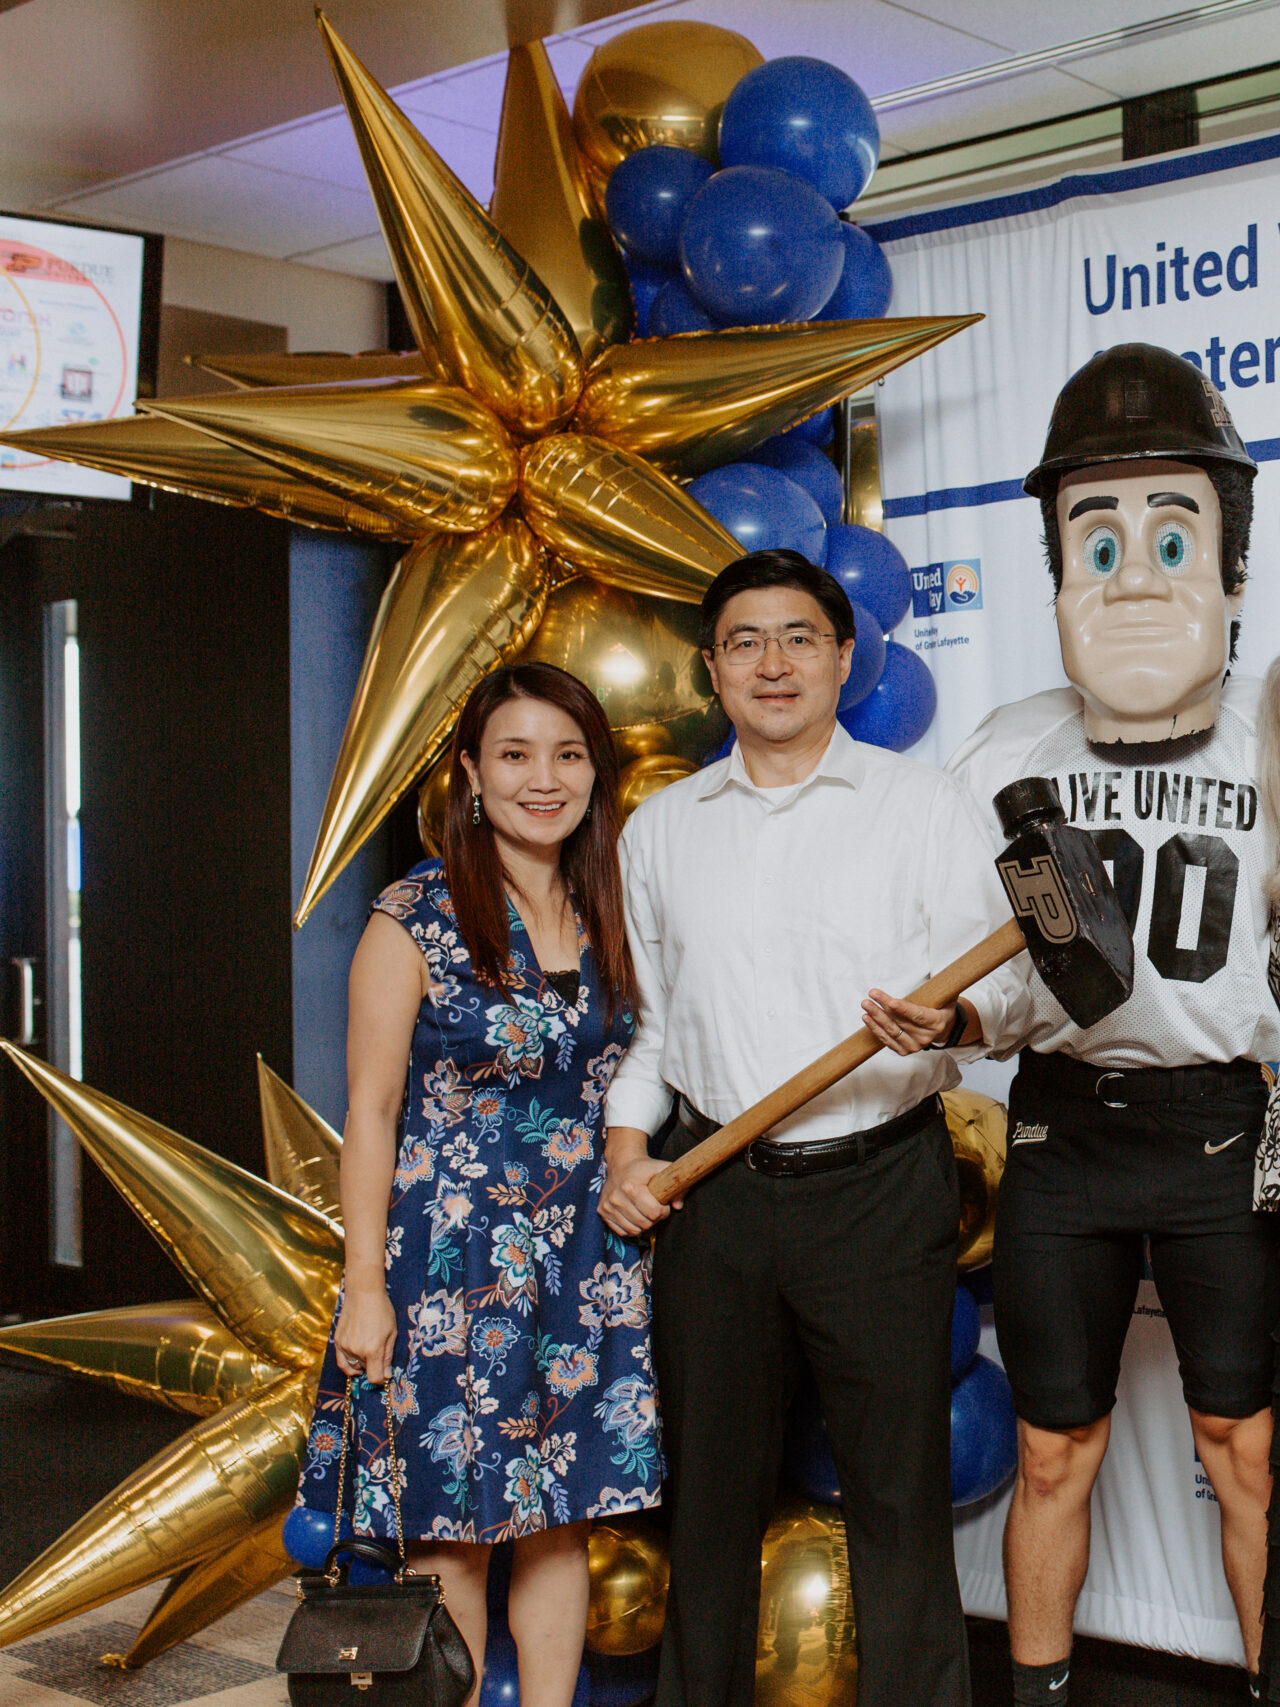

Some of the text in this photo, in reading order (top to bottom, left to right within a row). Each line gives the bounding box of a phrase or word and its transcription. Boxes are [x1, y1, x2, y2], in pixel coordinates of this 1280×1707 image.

[1084, 222, 1259, 316] United
[937, 636, 970, 649] Lafayette
[1134, 770, 1258, 832] UNITED
[1012, 1121, 1049, 1142] Purdue
[1195, 1488, 1206, 1499] of
